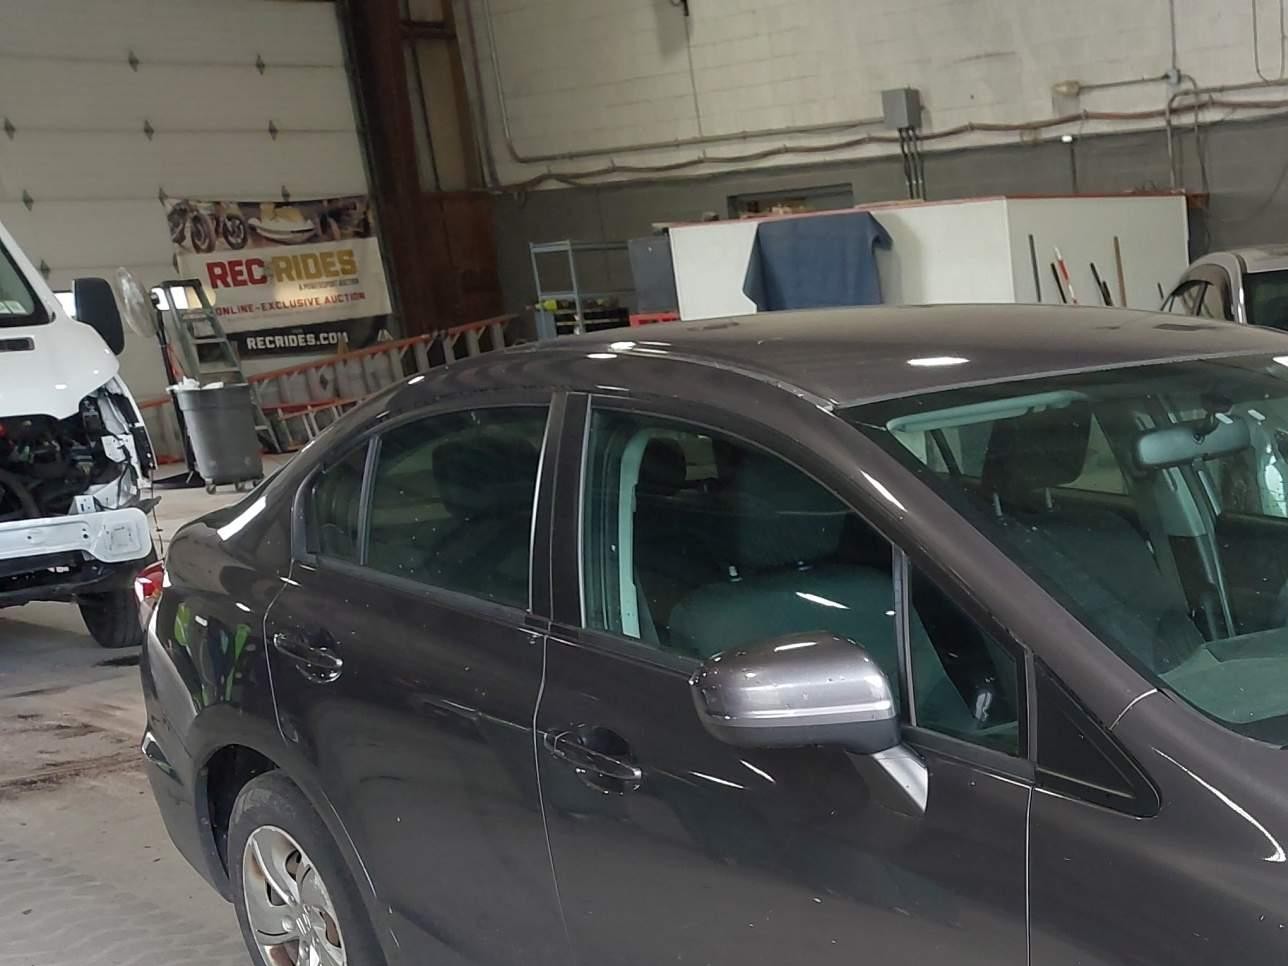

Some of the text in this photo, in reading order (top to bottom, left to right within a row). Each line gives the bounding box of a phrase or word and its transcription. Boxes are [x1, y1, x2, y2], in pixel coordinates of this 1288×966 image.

[206, 248, 358, 290] REC RIDES
[324, 292, 366, 304] AUCTION
